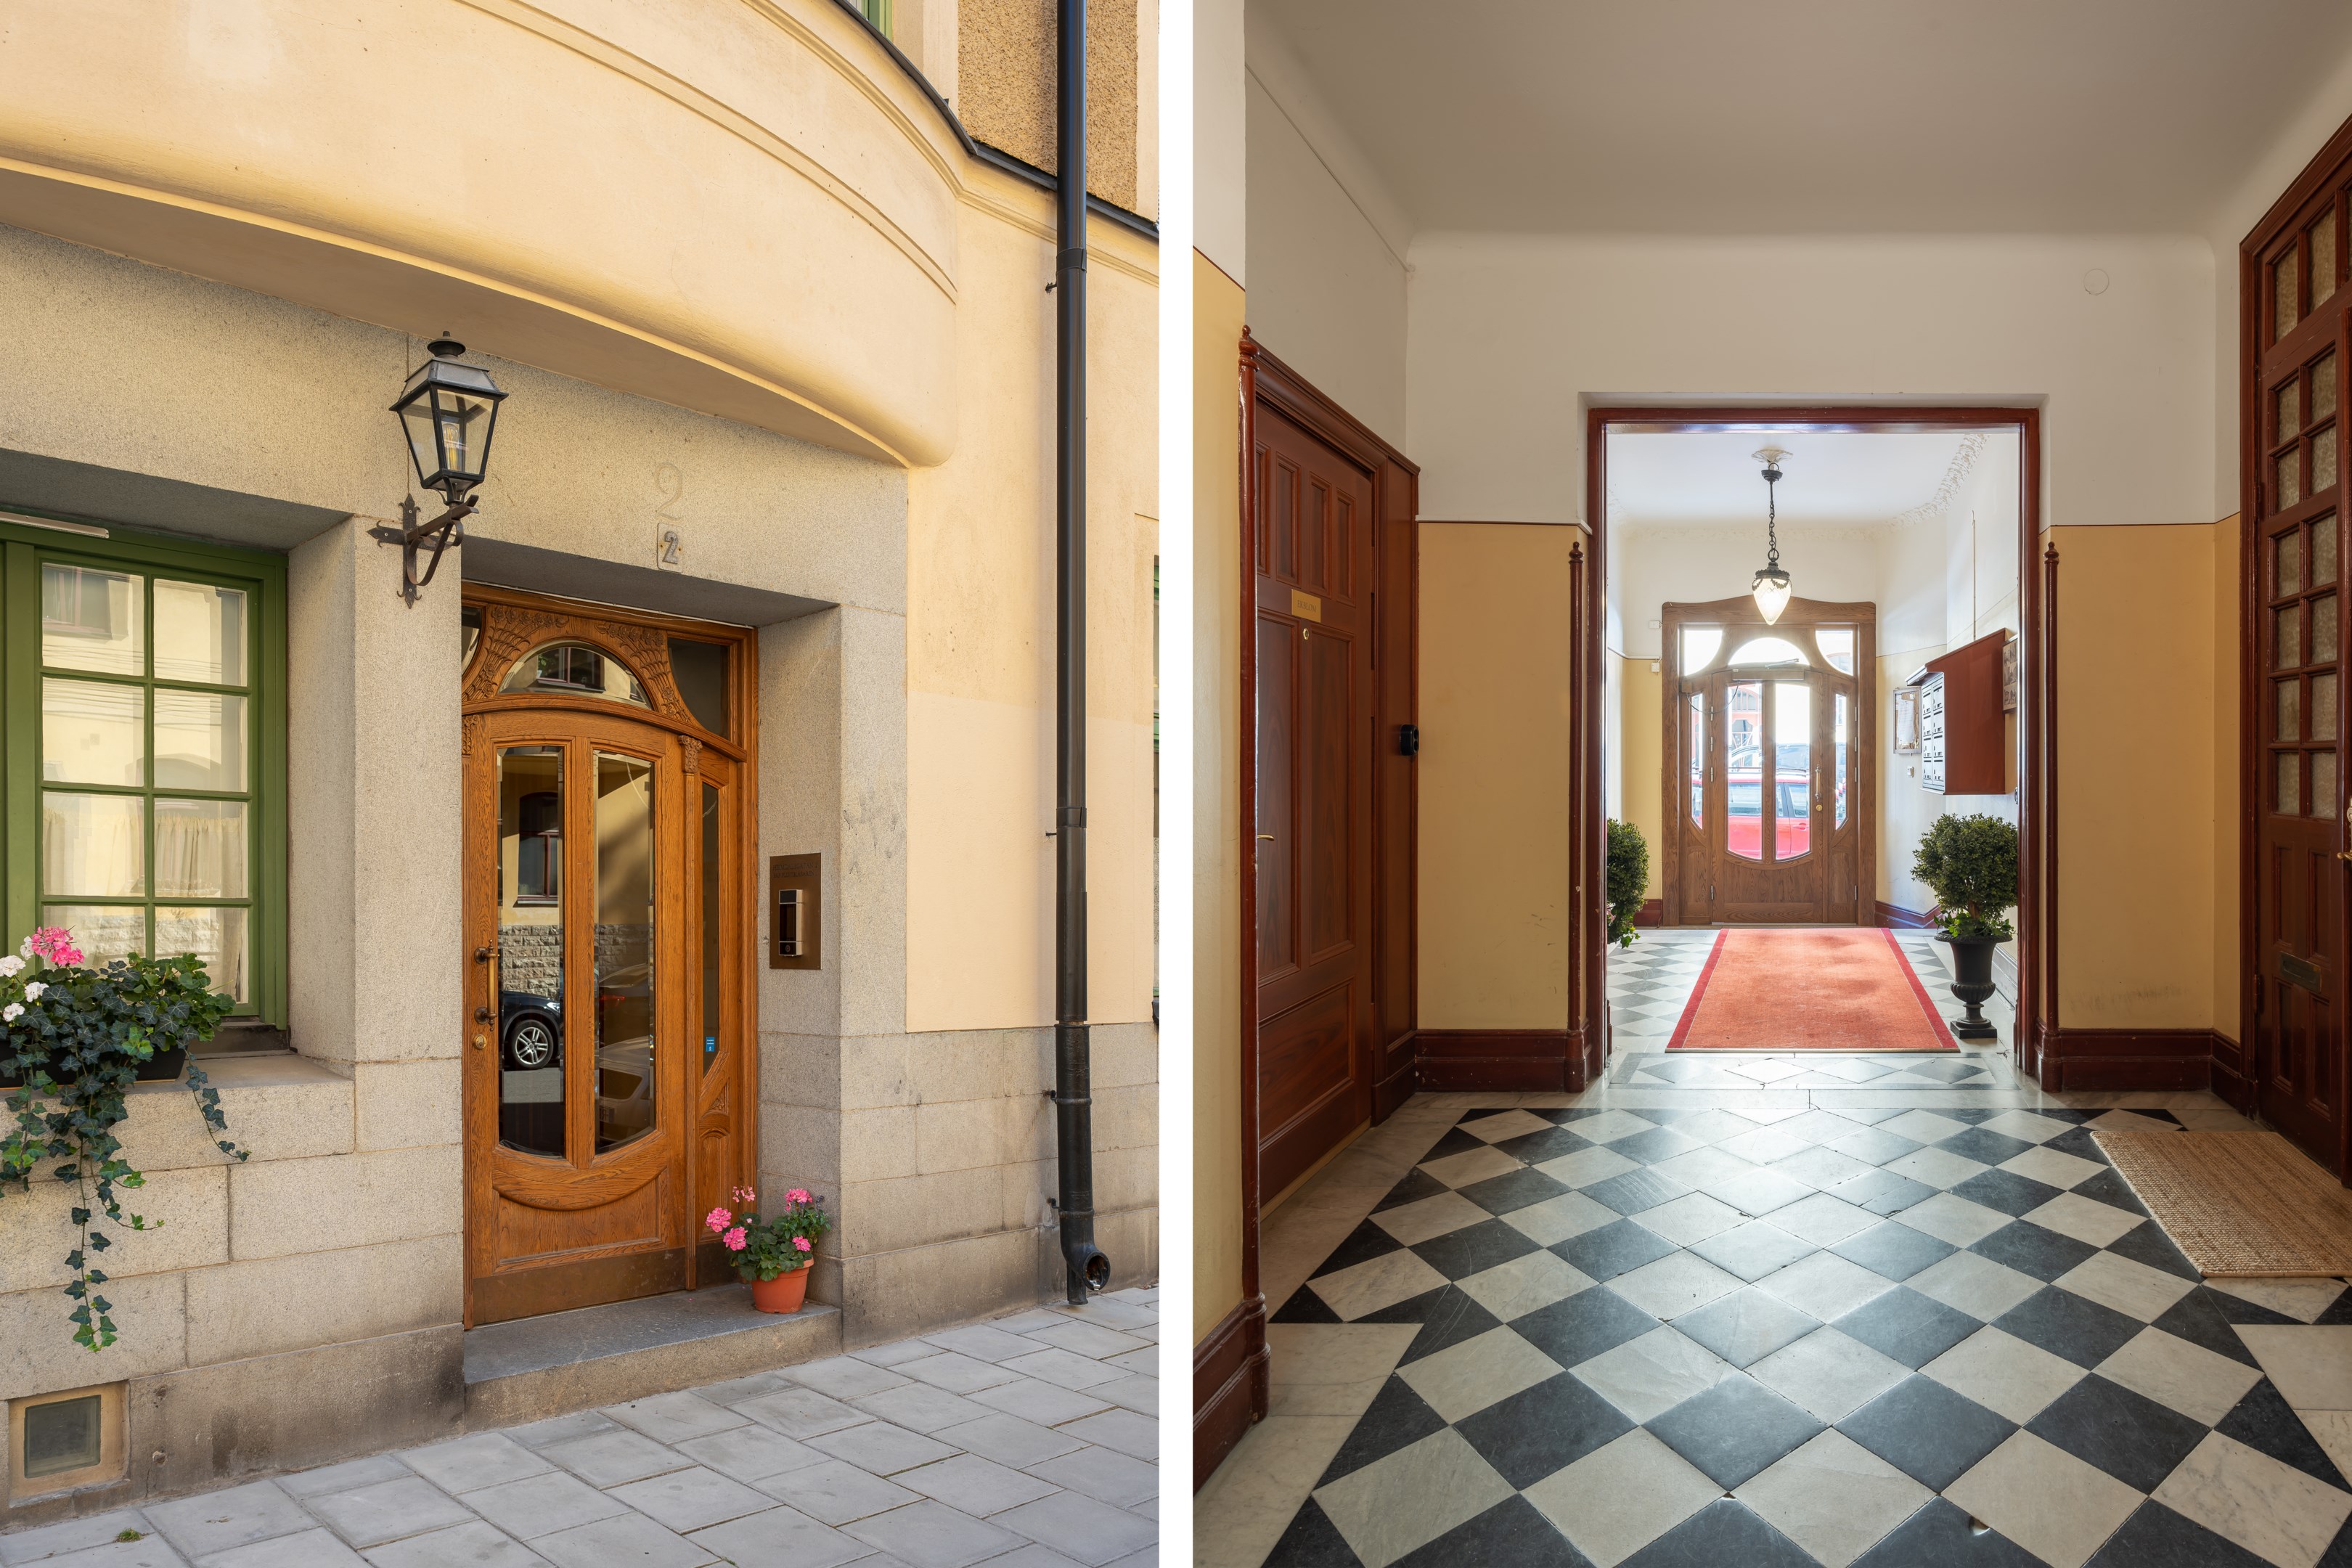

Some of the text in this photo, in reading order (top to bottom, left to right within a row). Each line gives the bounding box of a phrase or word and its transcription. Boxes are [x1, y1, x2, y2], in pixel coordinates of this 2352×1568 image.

[654, 461, 684, 523] 2
[662, 531, 679, 565] 2
[1297, 600, 1317, 613] EKBLOM
